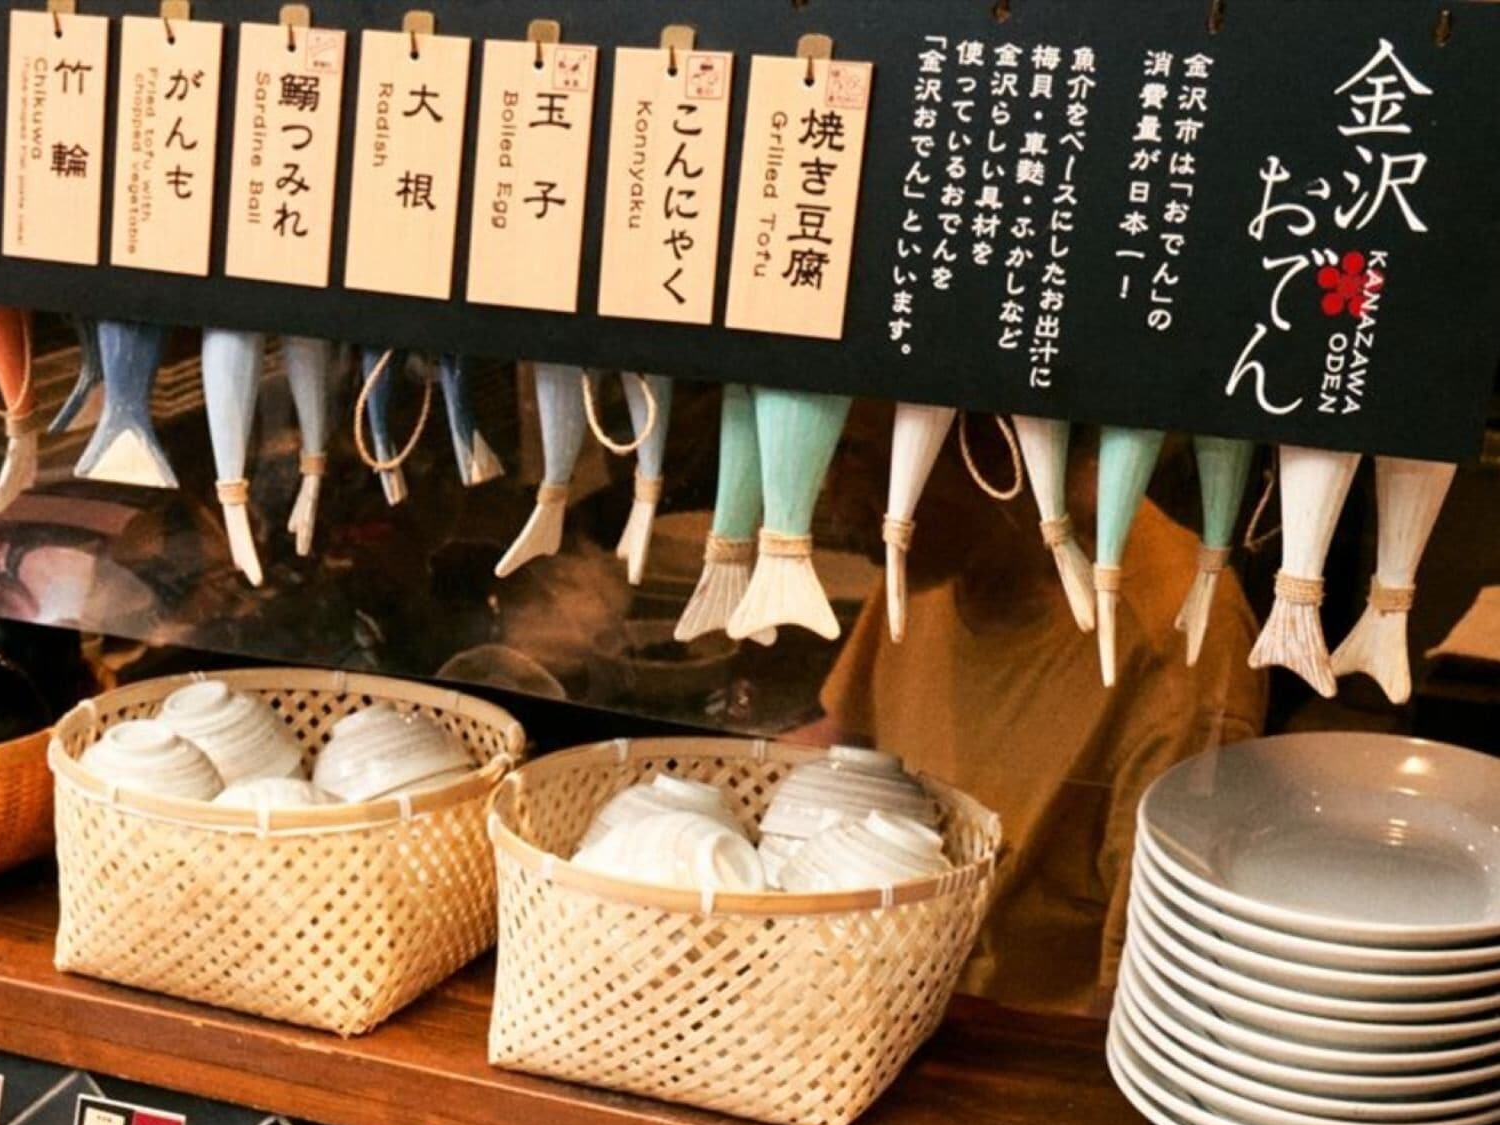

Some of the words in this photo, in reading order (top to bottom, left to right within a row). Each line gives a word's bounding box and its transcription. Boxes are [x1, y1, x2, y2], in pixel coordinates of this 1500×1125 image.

[31, 57, 48, 160] Chikuwa
[50, 58, 93, 178] 竹輪
[132, 73, 145, 153] chopped
[143, 129, 156, 170] tofu
[145, 67, 158, 118] Fried
[164, 68, 205, 199] がんも
[250, 71, 271, 167] Sardine
[373, 83, 393, 168] Radish
[395, 83, 443, 212] 大根
[498, 90, 518, 169] Boiled
[972, 42, 1023, 266] 金沢らしい具材を
[1334, 38, 1433, 232] 金沢
[127, 162, 140, 255] vegetable
[141, 181, 153, 222] with
[247, 180, 264, 224] Ball
[273, 73, 320, 237] 鰯つみれ
[492, 182, 513, 230] Egg
[523, 92, 573, 220] 玉子
[628, 101, 653, 230] Konnyaku
[662, 103, 704, 304] こんにゃく
[763, 110, 789, 200] Grilled
[782, 108, 845, 290] 焼き豆腐
[888, 35, 947, 354] 「金沢おでん」といいます。
[931, 40, 985, 290] 使っているおでんを
[1147, 53, 1214, 332] 金沢市は「おでん」の
[753, 213, 777, 278] Tofu
[1029, 47, 1096, 389] 魚介をベースにしたお出汁に
[1225, 156, 1339, 415] おでん
[1342, 250, 1388, 415] KANAZAWA
[1317, 333, 1348, 413] ODEN
